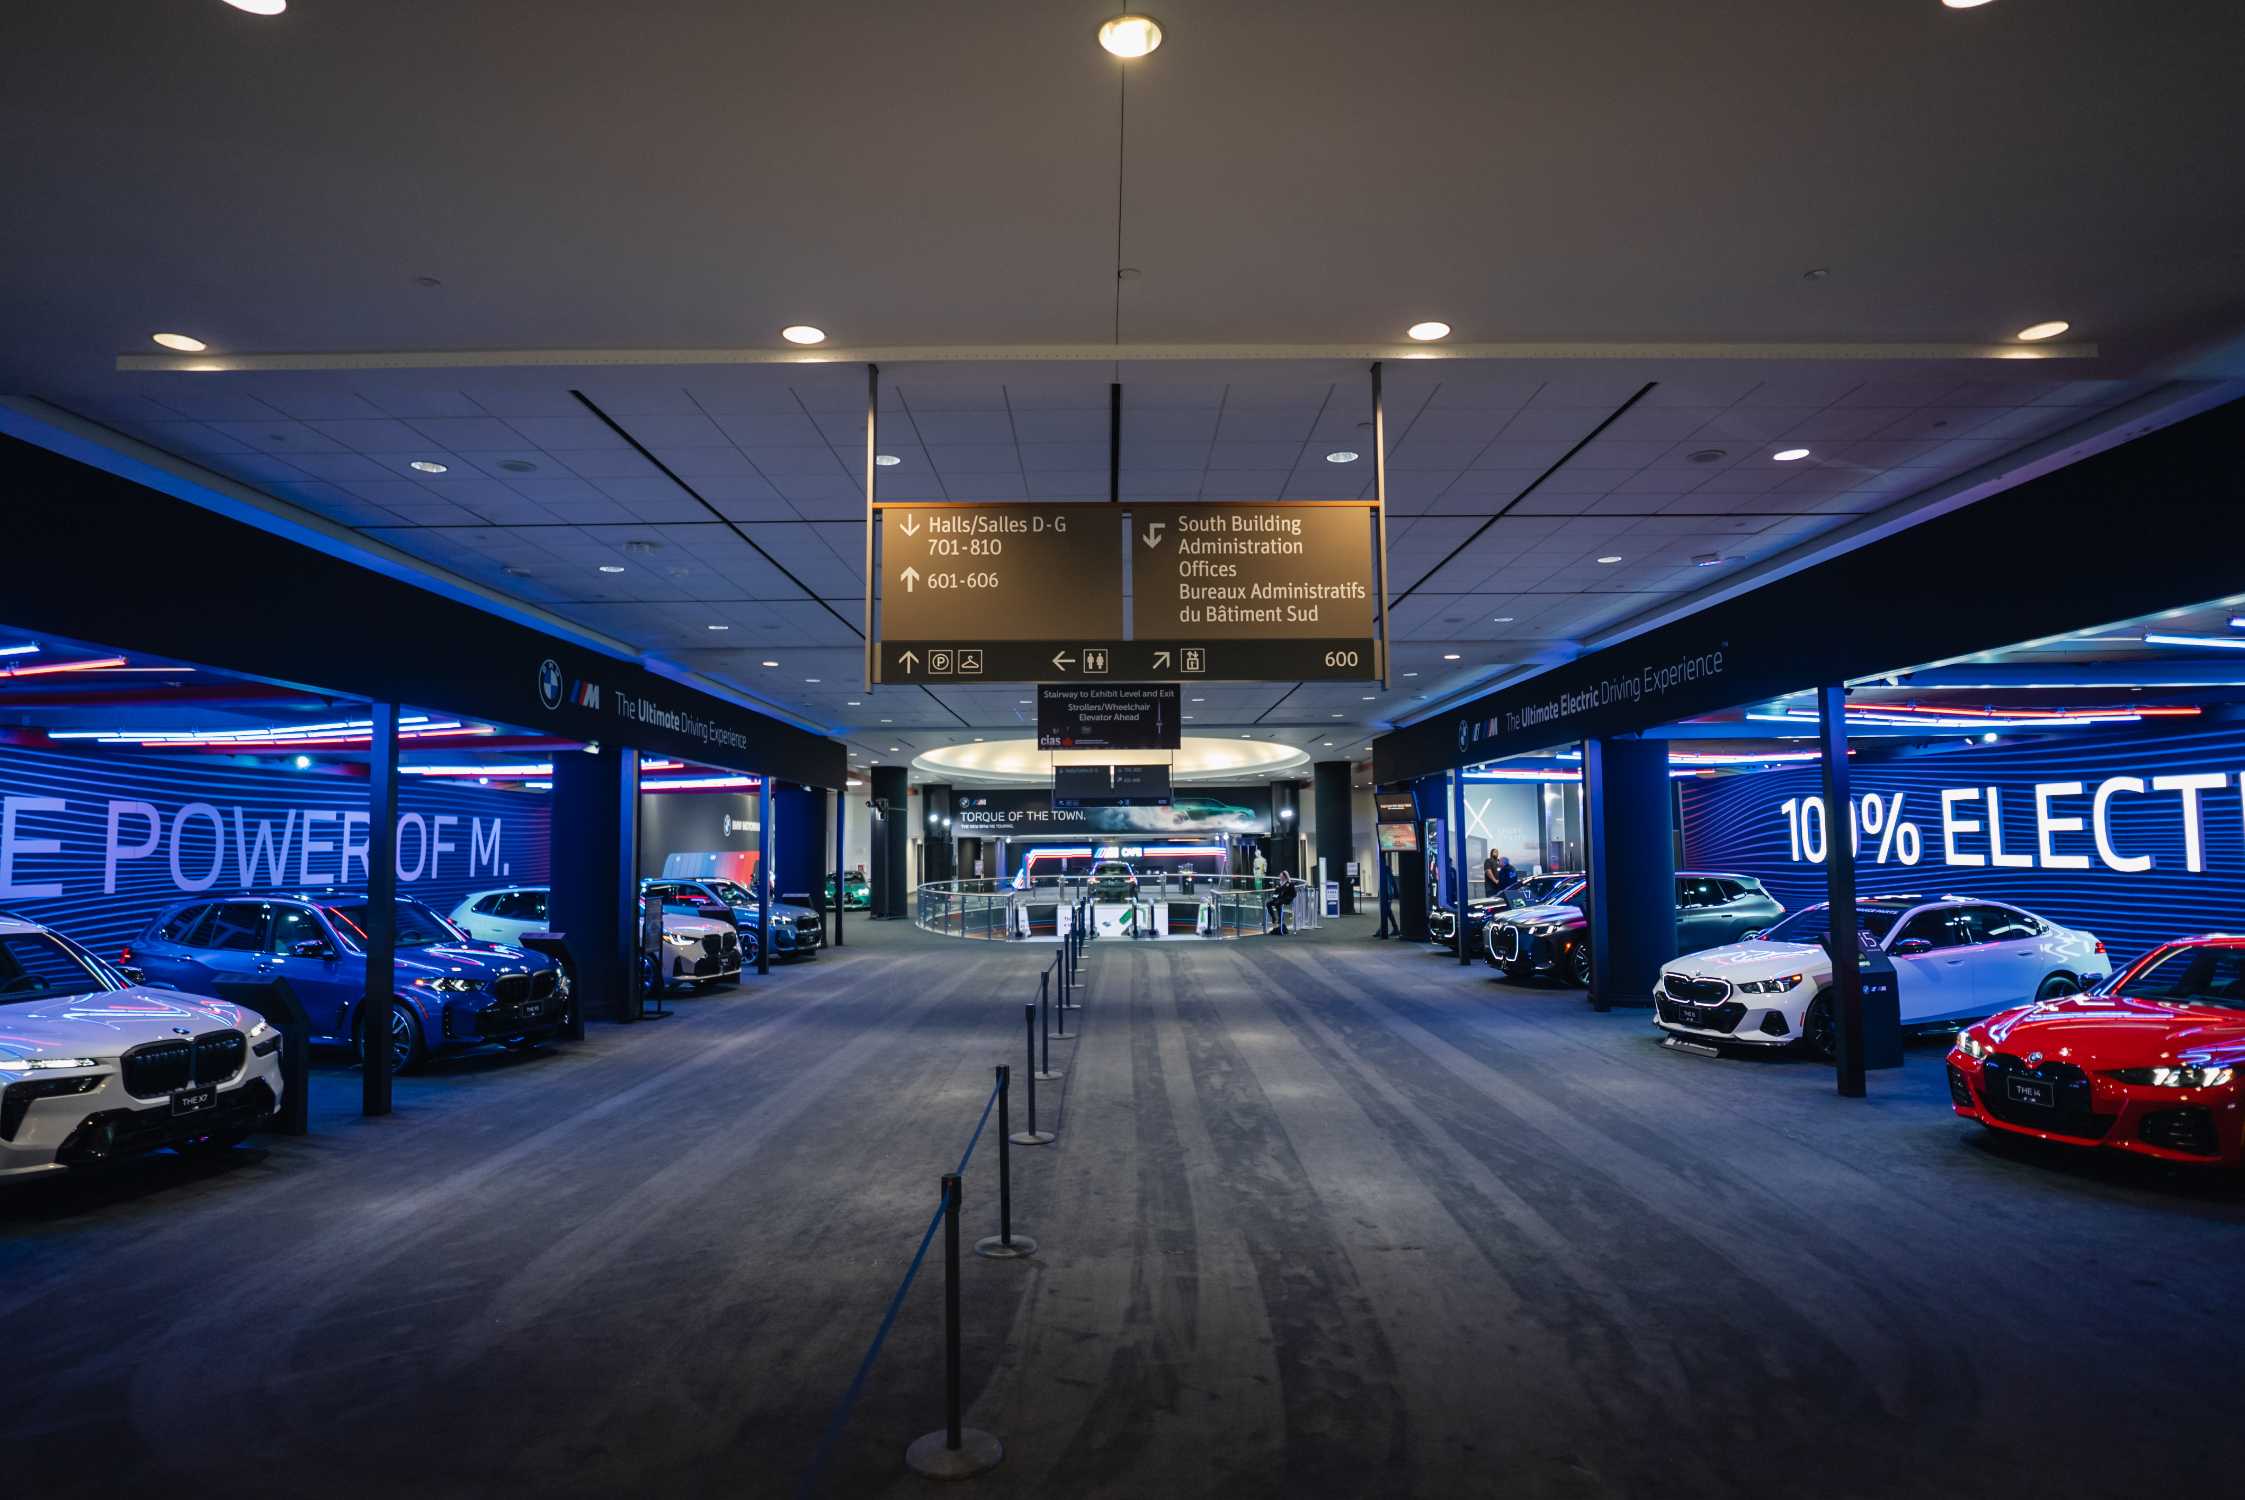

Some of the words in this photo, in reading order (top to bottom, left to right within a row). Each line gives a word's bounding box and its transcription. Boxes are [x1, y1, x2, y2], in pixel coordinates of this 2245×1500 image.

[929, 515, 1027, 535] Halls/Salles
[1178, 515, 1226, 532] South
[1232, 515, 1301, 535] Building
[928, 539, 1002, 555] 701-810
[1178, 538, 1303, 554] Administration
[1179, 560, 1237, 577] Offices
[928, 572, 999, 588] 601-606
[1179, 583, 1246, 599] Bureaux
[1251, 581, 1366, 599] Administratifs
[1180, 605, 1201, 622] du
[1207, 605, 1282, 622] Bâtiment
[1287, 605, 1318, 622] Sud
[1324, 651, 1358, 667] 600
[1043, 690, 1079, 699] Stairway
[1090, 690, 1118, 698] Exhibit
[1119, 690, 1141, 698] Level
[1142, 690, 1158, 698] and
[1159, 689, 1175, 698] Exit
[1506, 712, 1520, 732] The
[1521, 702, 1559, 727] Ultimate
[1560, 686, 1599, 717] Electric
[1600, 676, 1641, 704] Driving
[1644, 651, 1723, 695] Experience
[1067, 703, 1150, 711] Strollers/Wheelchair
[615, 690, 636, 719] The
[638, 698, 680, 732] Ultimate
[681, 712, 708, 743] Driving
[709, 720, 747, 749] Experience
[1079, 713, 1112, 721] Elevator
[1113, 713, 1140, 721] Ahead
[960, 811, 1005, 823] TORQUE
[1008, 811, 1024, 821] OF
[1027, 811, 1049, 821] THE
[1051, 810, 1087, 821] TOWN.
[1781, 792, 1922, 866] 10%
[1942, 772, 2245, 873] ELECT
[104, 800, 370, 894] POWER
[396, 812, 458, 881] OF
[469, 816, 510, 877] M.
[2016, 1085, 2032, 1096] THE
[182, 1096, 198, 1106] THE
